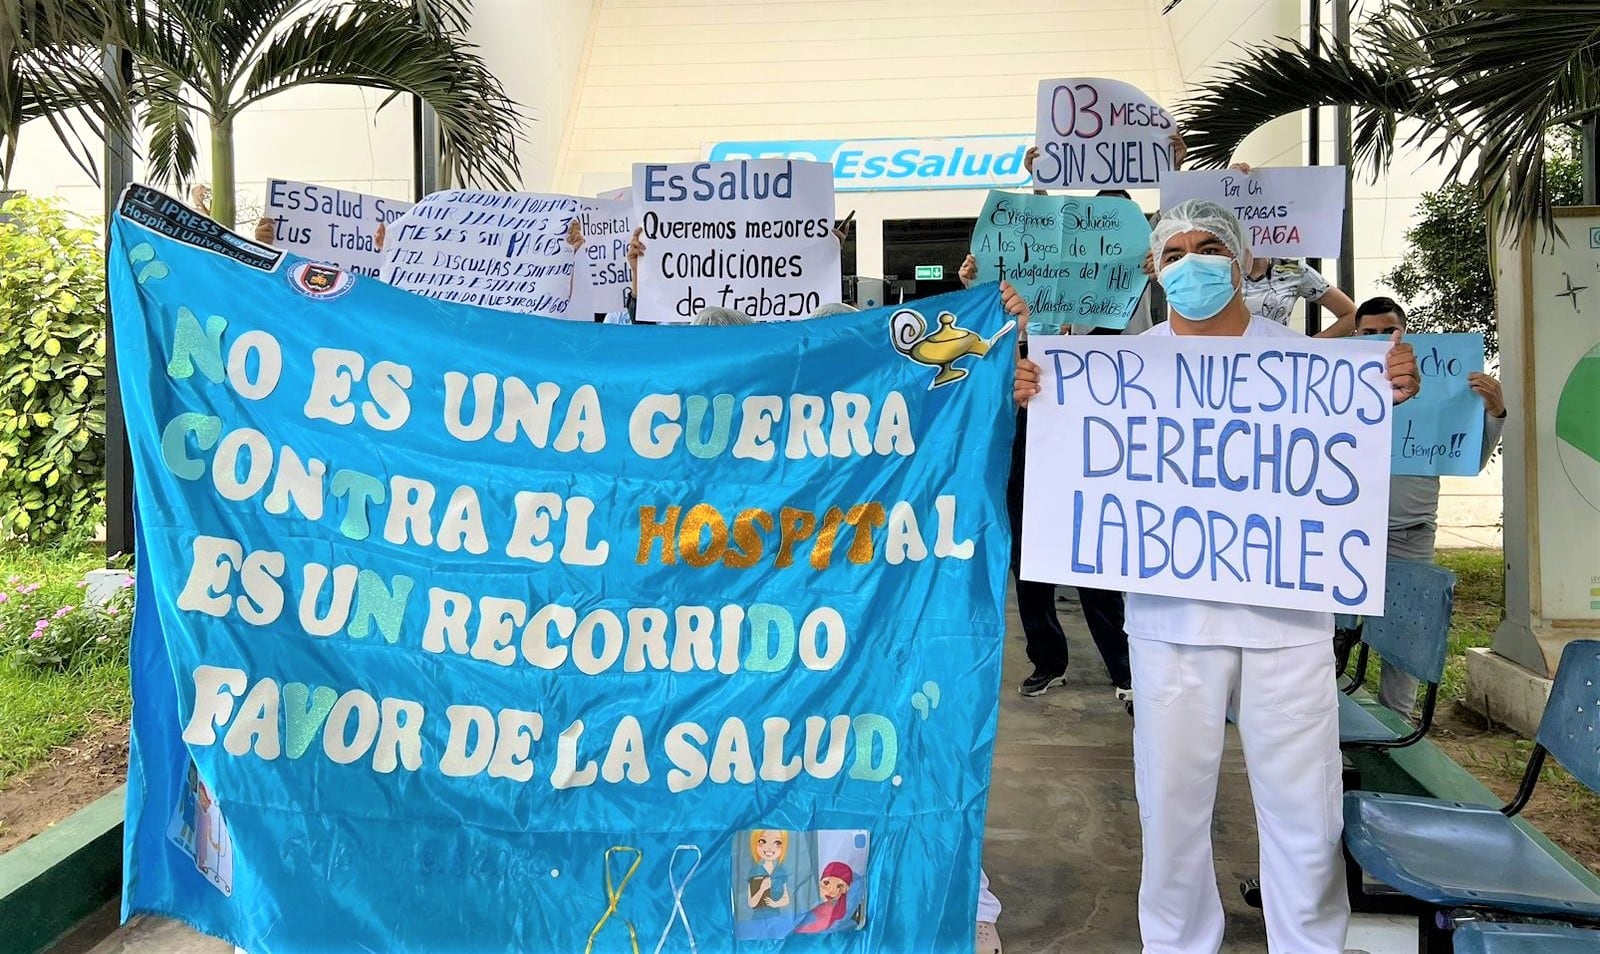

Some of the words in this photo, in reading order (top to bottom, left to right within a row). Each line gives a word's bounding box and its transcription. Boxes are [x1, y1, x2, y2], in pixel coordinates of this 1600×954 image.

[1051, 84, 1103, 139] 03
[1110, 102, 1172, 129] MESES
[834, 144, 1026, 179] EsSalud
[1036, 141, 1086, 187] SIN
[644, 160, 793, 203] EsSalud
[1220, 176, 1241, 197] Por
[270, 180, 363, 220] EsSalud
[989, 199, 1056, 234] Exigimos
[160, 199, 220, 237] IPRESS
[273, 214, 312, 244] tus
[397, 224, 467, 243] MESES
[478, 230, 505, 246] SIN
[554, 216, 573, 236] 3
[582, 212, 631, 237] Hospital
[642, 211, 736, 240] Queremos
[123, 202, 182, 237] Hospital
[181, 230, 273, 270] Universitario
[980, 234, 991, 253] A
[998, 231, 1016, 253] los
[1020, 233, 1059, 264] Pagos
[1069, 237, 1087, 257] de
[1100, 235, 1122, 256] los
[390, 247, 425, 265] MIL
[432, 250, 512, 277] DISCULPAS
[661, 248, 802, 279] condiciones
[994, 255, 1071, 286] trabajadores
[1079, 261, 1099, 280] del
[676, 286, 706, 317] de
[1413, 346, 1463, 378] cho
[166, 305, 283, 401] NO
[303, 347, 413, 432] ES
[443, 370, 607, 454] UNA
[628, 390, 916, 461] GUERRA
[1044, 348, 1158, 410] POR
[1175, 349, 1386, 426] NUESTROS
[1082, 415, 1361, 506] DERECHOS
[161, 411, 490, 555] CONTRA
[505, 490, 610, 566] EL
[634, 493, 976, 571] HOSPITAL
[1070, 489, 1371, 607] LABORALES
[176, 535, 286, 626] ES
[298, 562, 415, 644] UN
[421, 586, 847, 676] RECORRIDO
[181, 664, 426, 774] FAVOR
[438, 704, 544, 783] DE
[549, 715, 651, 791] LA
